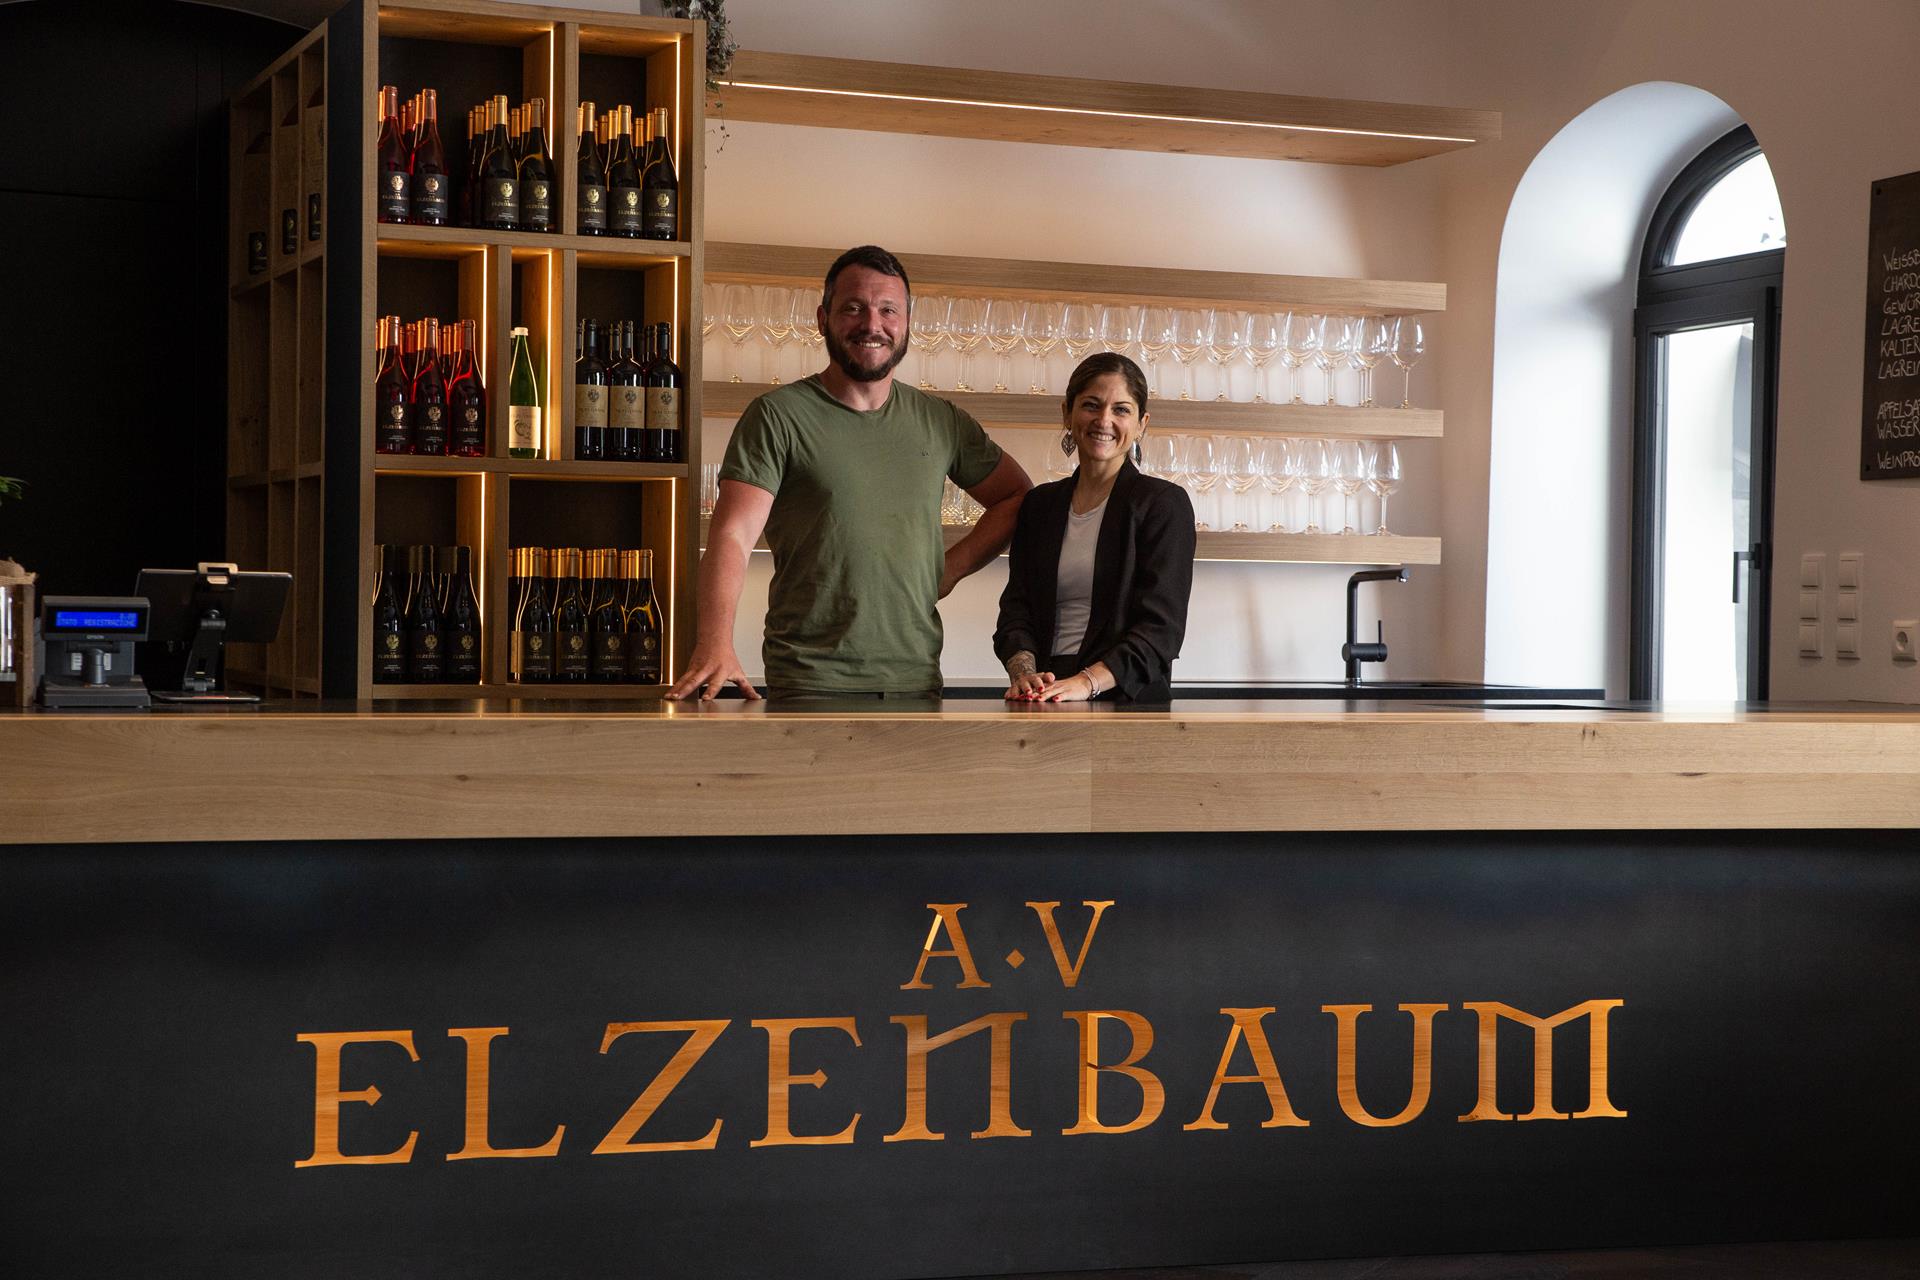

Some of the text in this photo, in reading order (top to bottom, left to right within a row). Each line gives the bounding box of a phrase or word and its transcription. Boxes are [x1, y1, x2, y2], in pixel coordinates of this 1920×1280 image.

[1877, 398, 1920, 420] APFELSA
[1877, 450, 1920, 470] WEINPRO
[294, 998, 1628, 1168] ELZENBAUM
